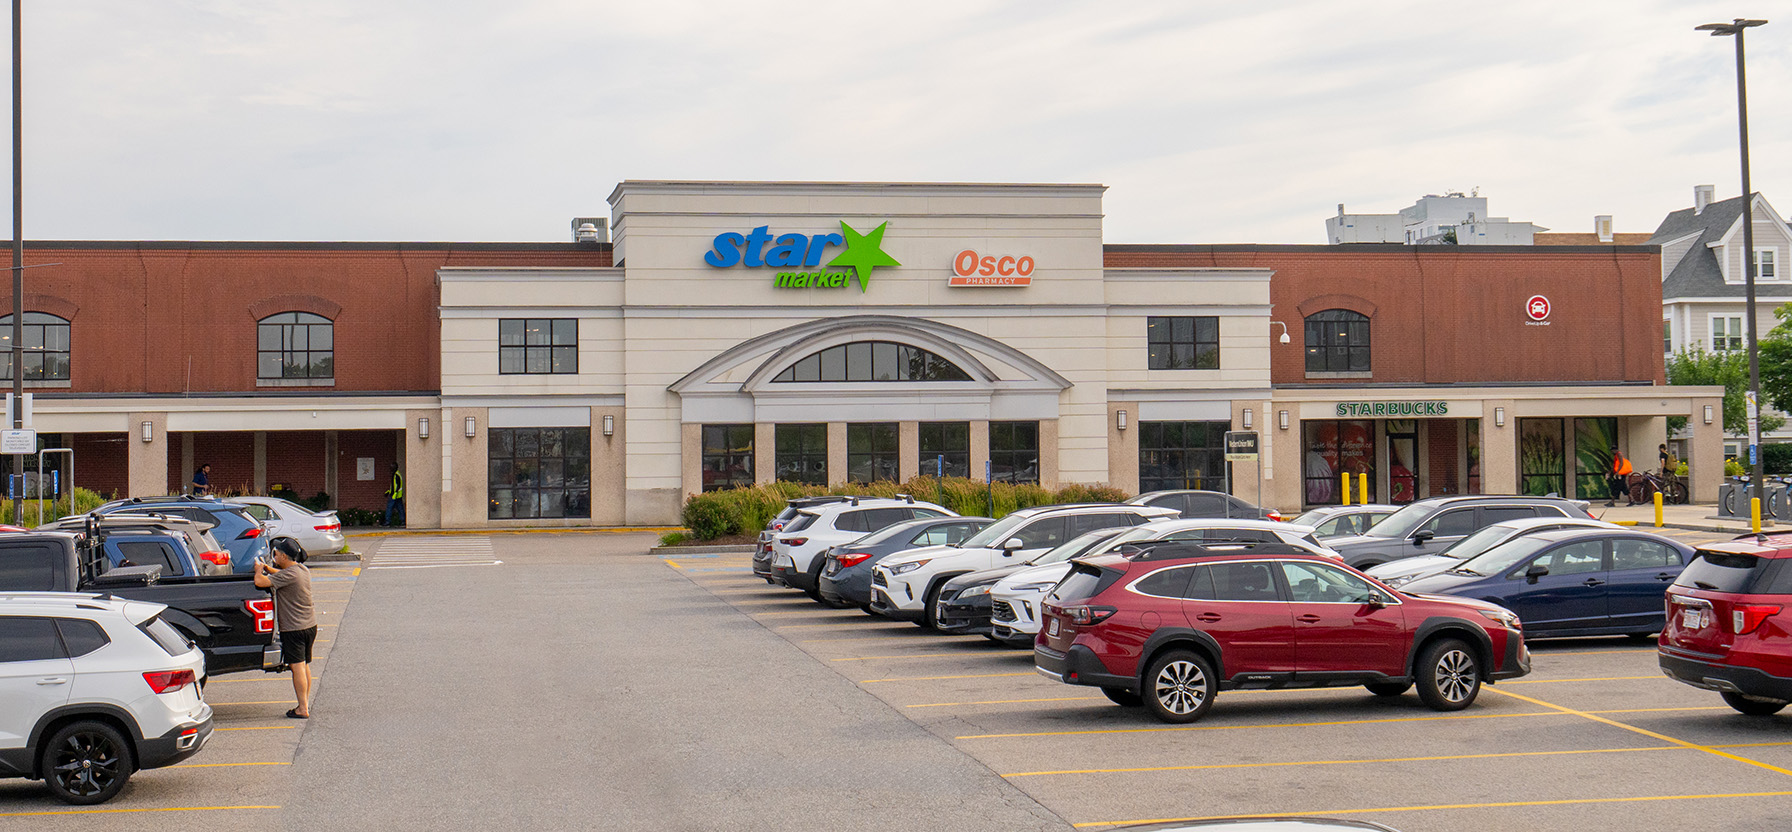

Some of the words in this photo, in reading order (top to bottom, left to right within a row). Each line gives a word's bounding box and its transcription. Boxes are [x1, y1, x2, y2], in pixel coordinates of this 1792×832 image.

[704, 225, 843, 268] star
[955, 250, 1035, 276] Osco
[774, 267, 854, 288] market
[1337, 402, 1448, 416] STARBUCKS
[1327, 440, 1337, 449] the
